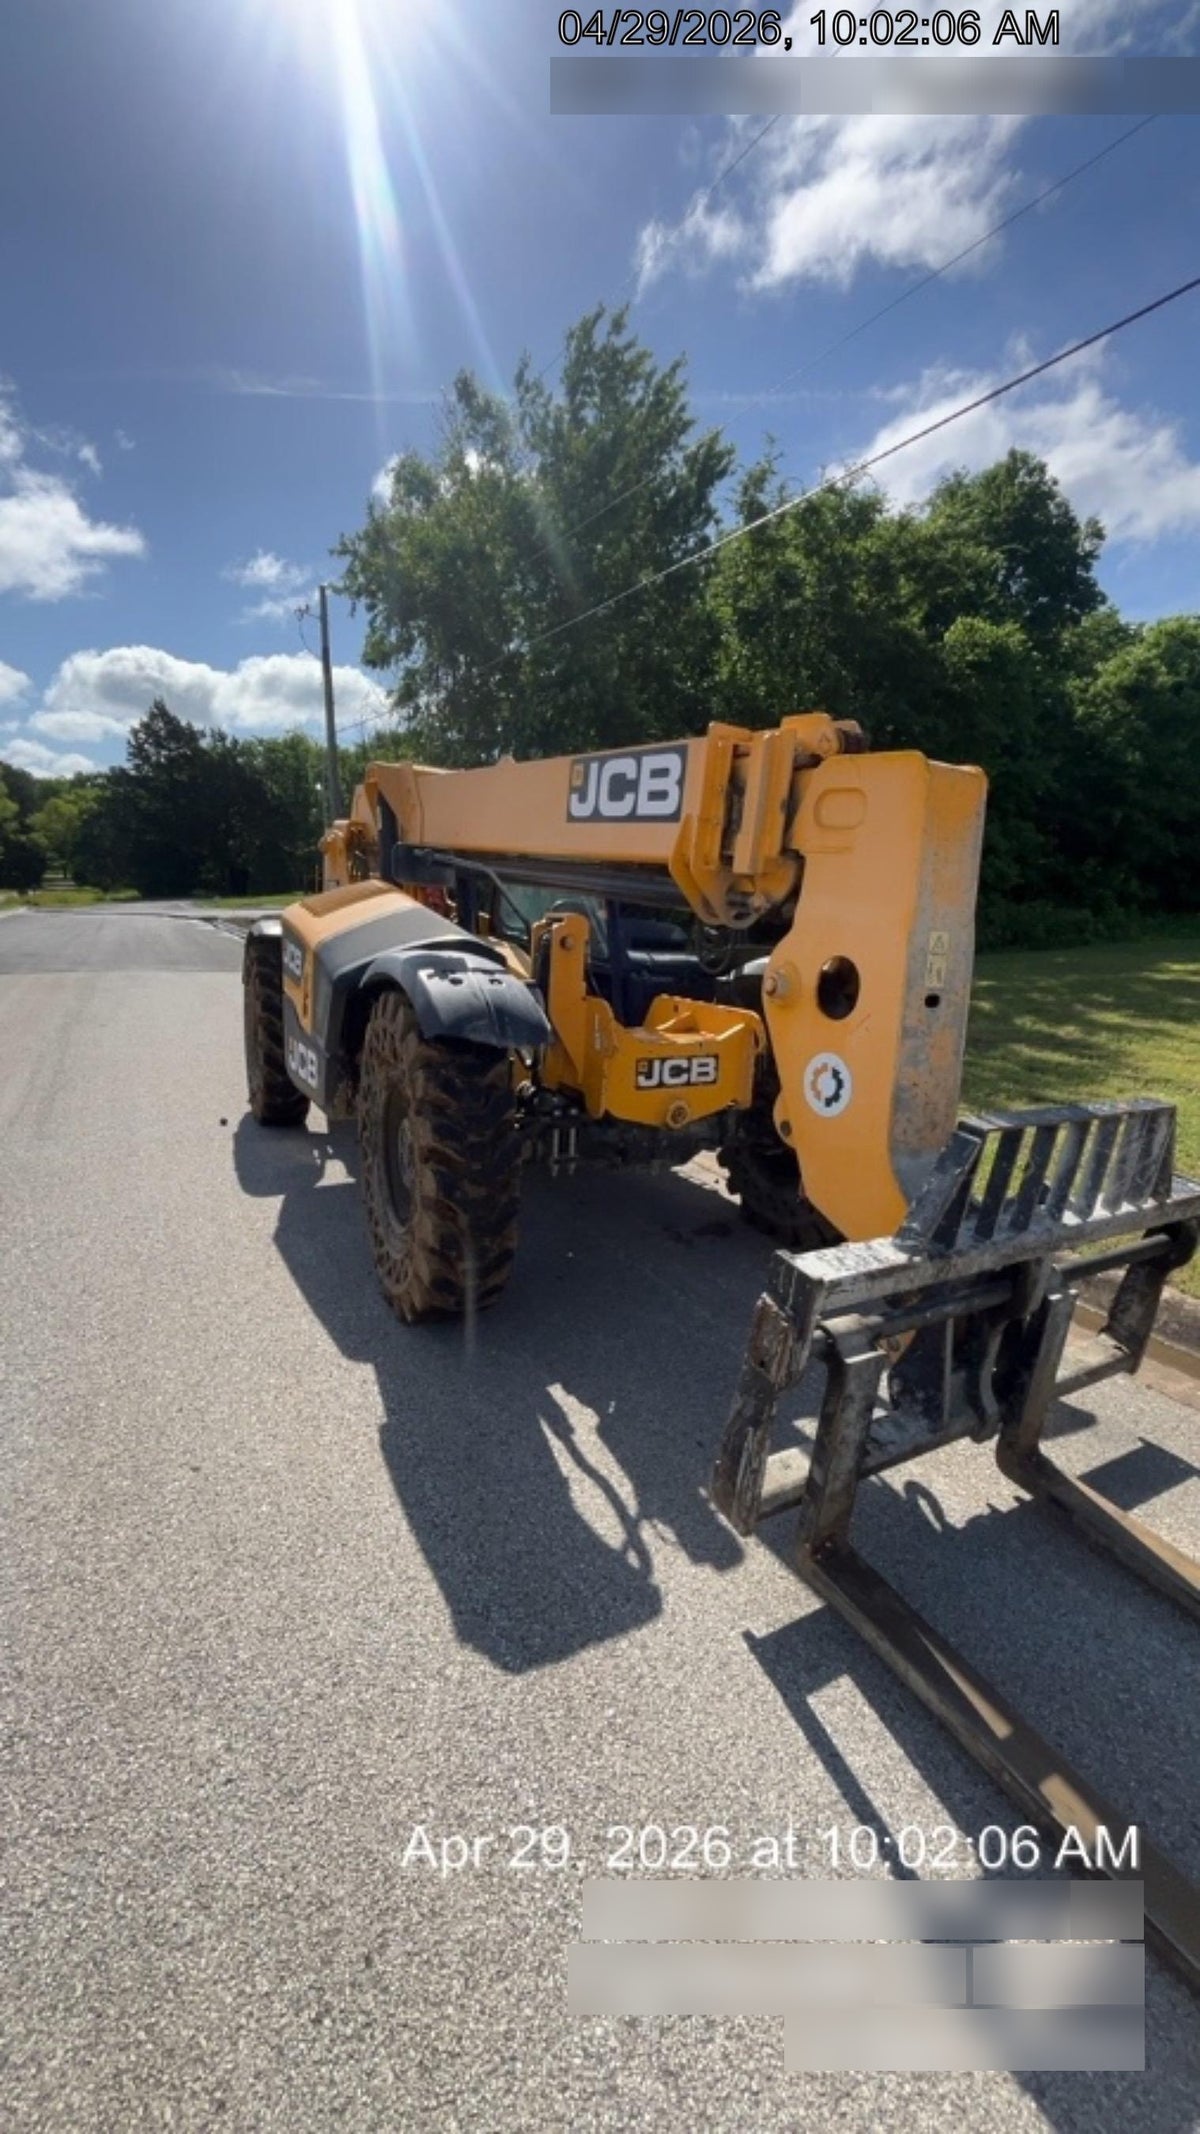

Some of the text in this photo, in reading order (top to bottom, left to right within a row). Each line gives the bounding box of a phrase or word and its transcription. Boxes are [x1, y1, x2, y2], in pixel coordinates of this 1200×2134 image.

[569, 753, 682, 817] JCB
[288, 1036, 318, 1089] JCB
[637, 1056, 717, 1088] JCB
